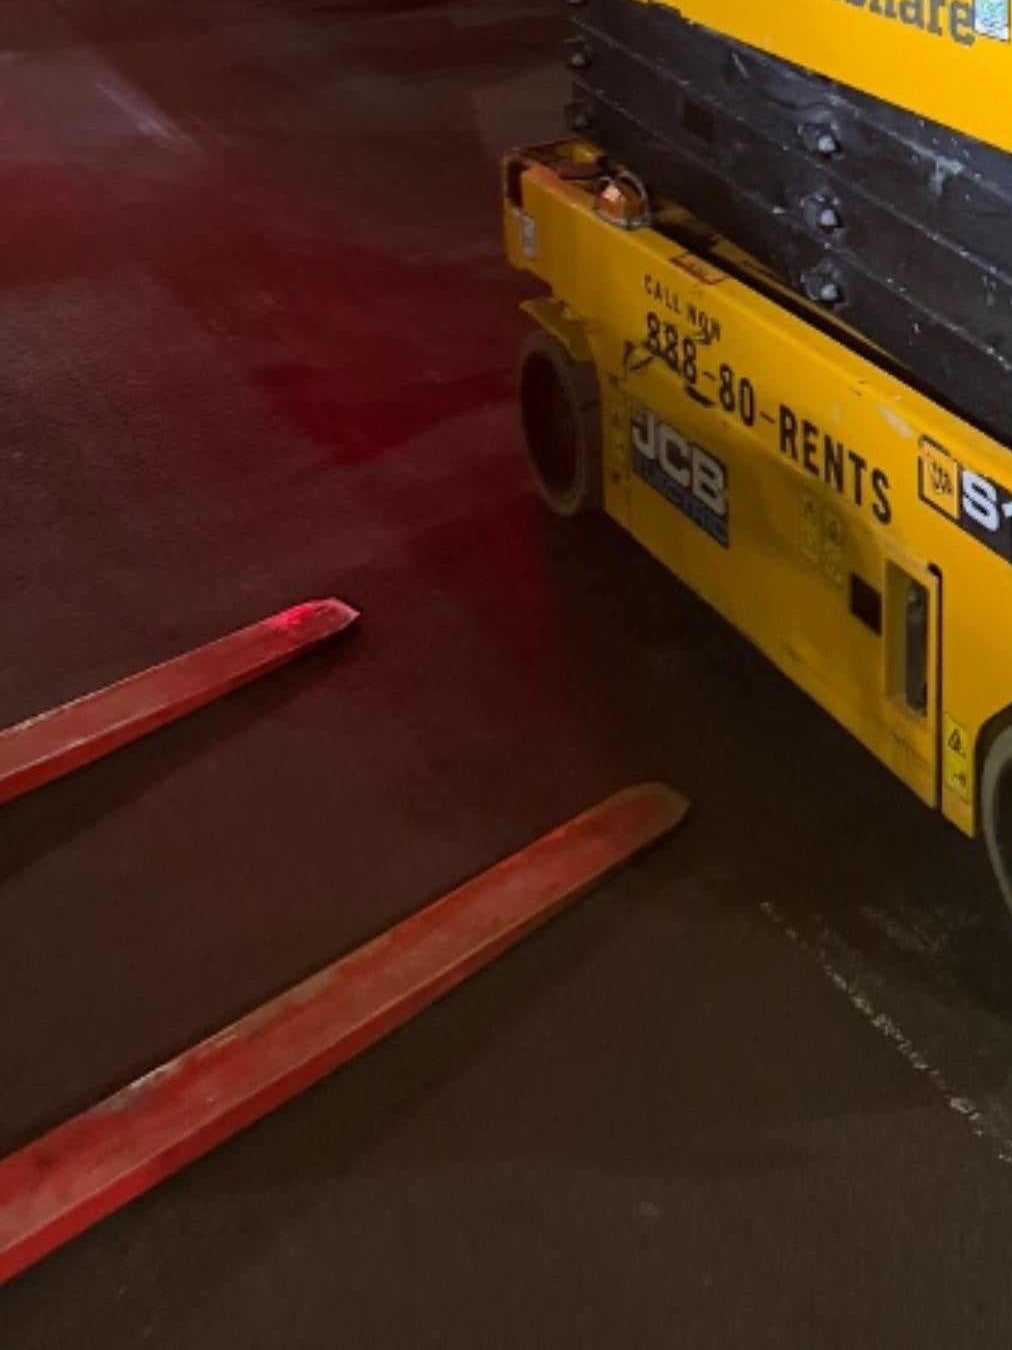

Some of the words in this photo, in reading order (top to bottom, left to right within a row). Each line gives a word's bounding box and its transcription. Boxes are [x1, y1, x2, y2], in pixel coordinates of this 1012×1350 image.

[644, 274, 681, 315] CALL
[631, 402, 726, 518] JCB
[646, 311, 892, 525] 888-80-RENTS
